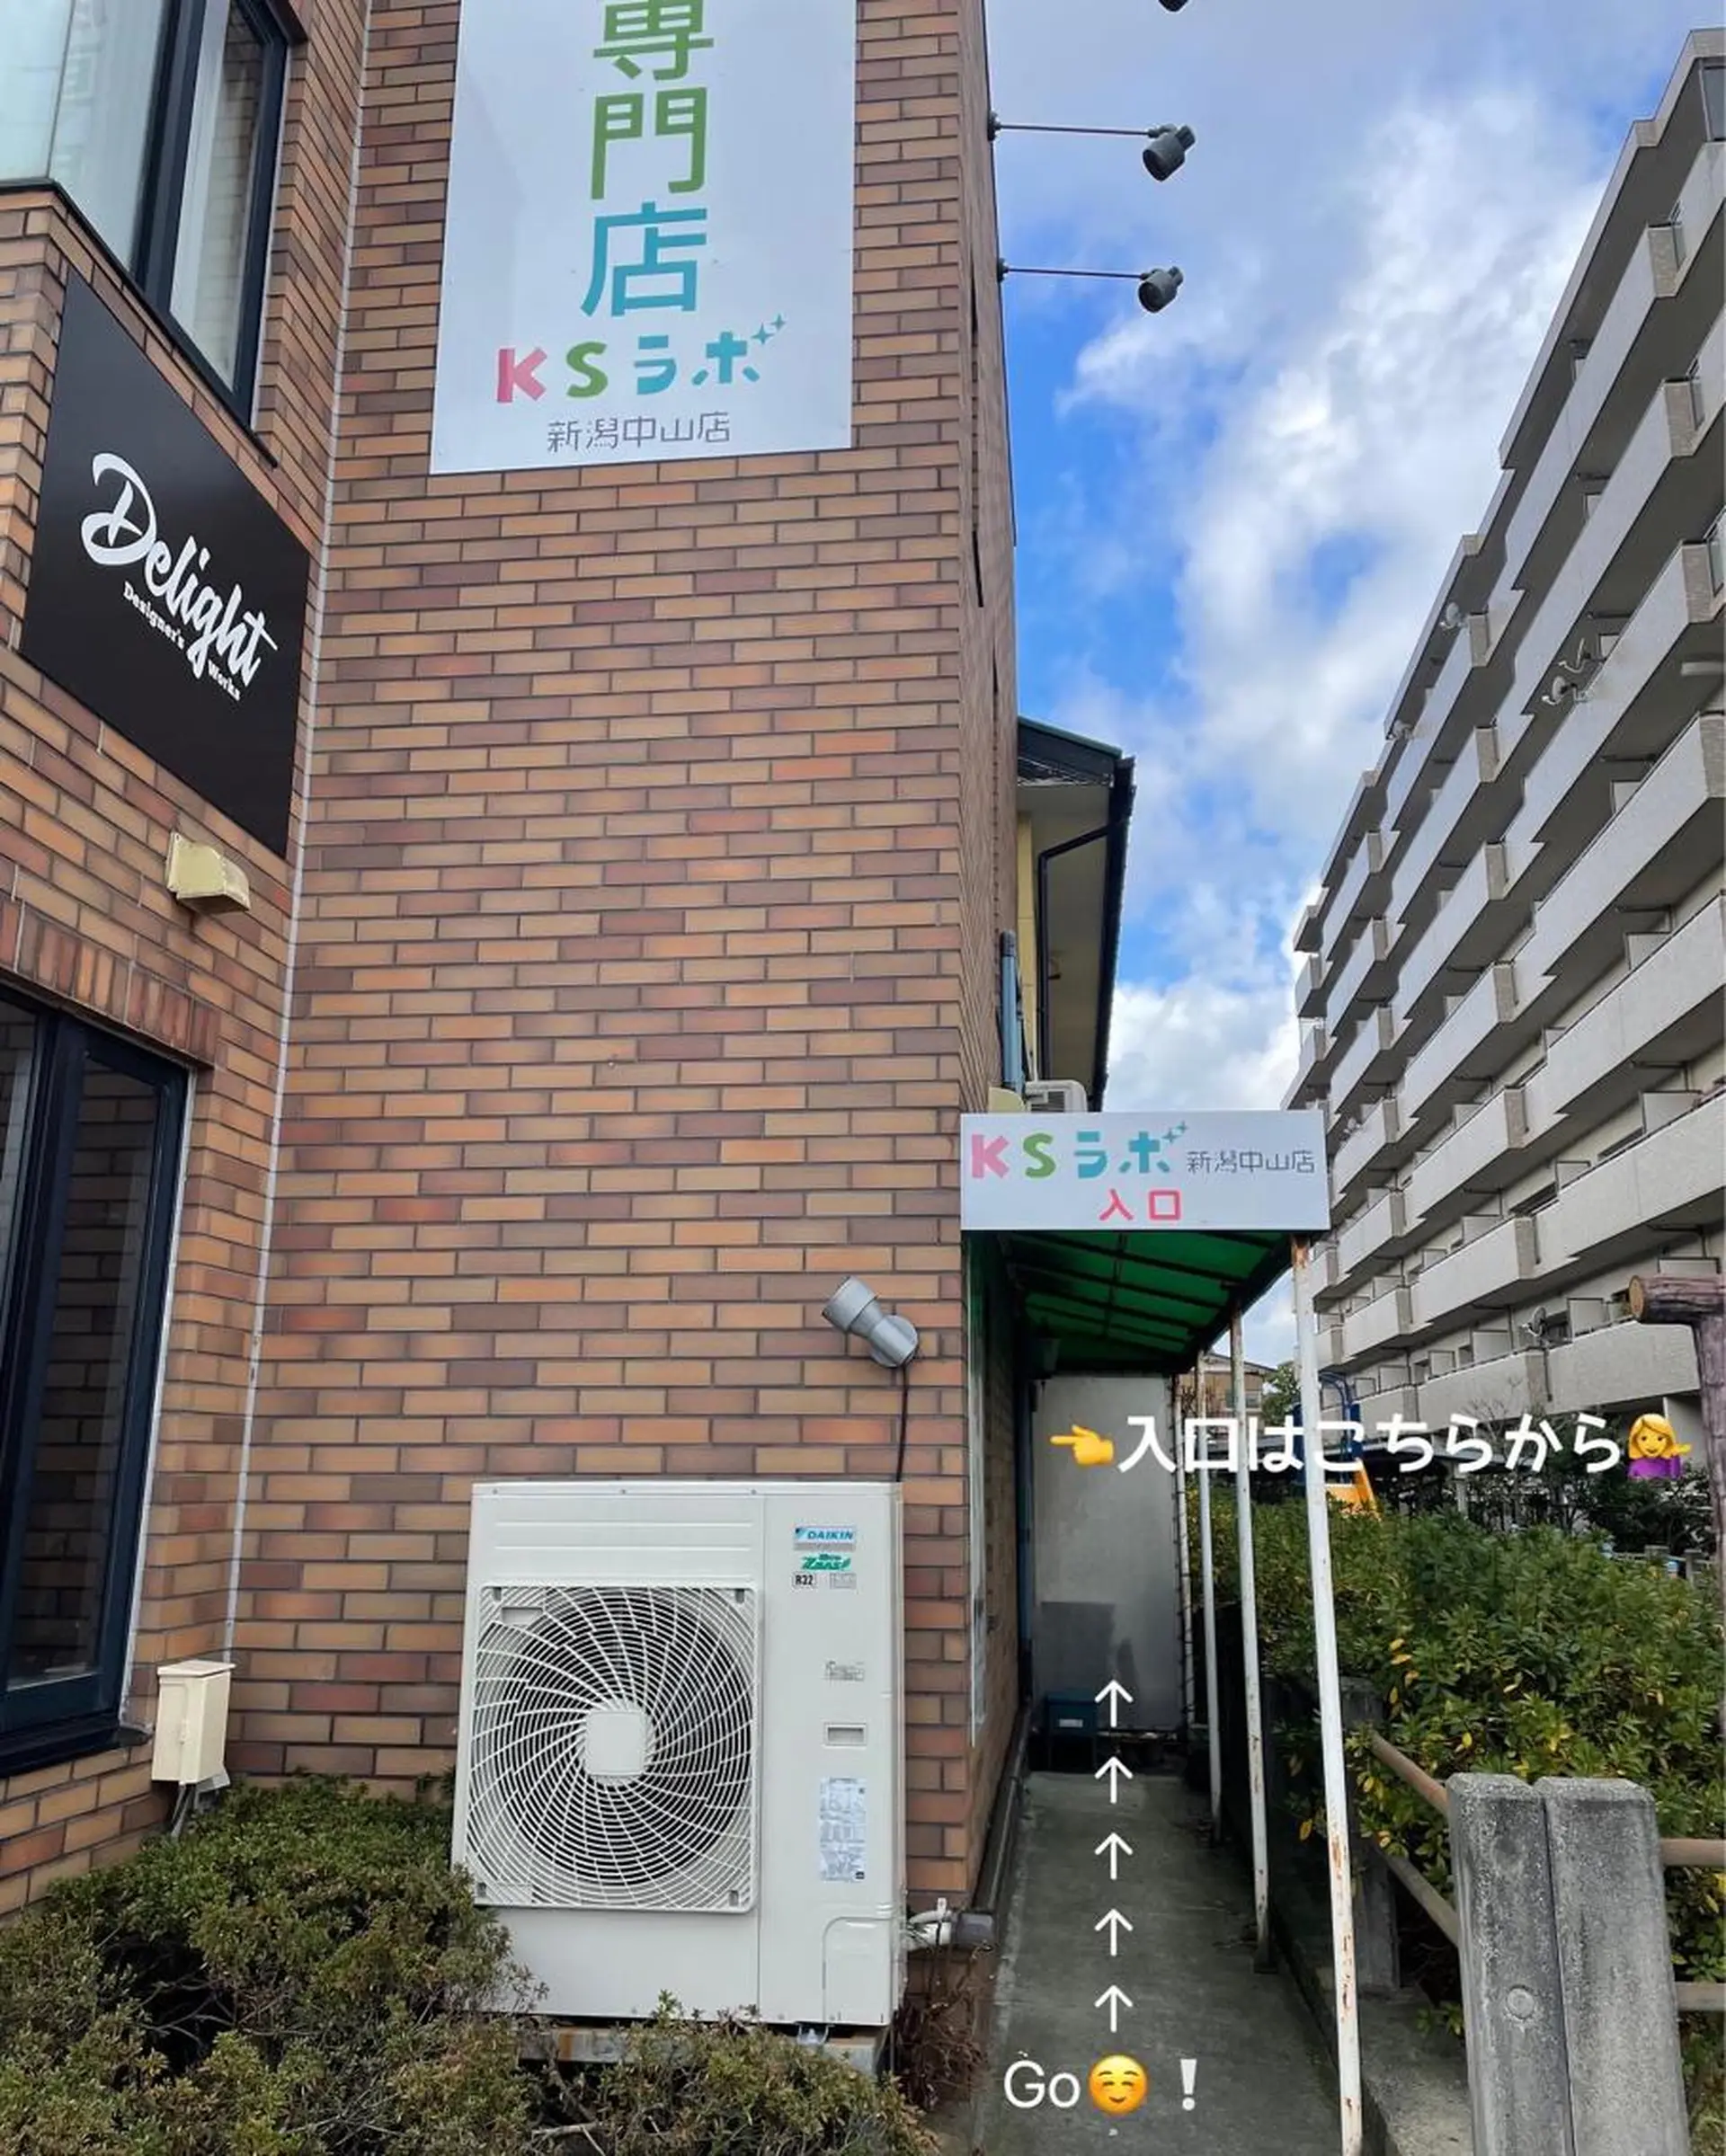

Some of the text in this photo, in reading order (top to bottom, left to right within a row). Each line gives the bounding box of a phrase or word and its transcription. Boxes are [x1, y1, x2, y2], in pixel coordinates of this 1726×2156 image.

[580, 0, 715, 317] 専門店
[547, 412, 731, 453] 新潟中山店
[81, 452, 278, 687] Delight
[207, 659, 242, 701] Works
[1187, 1149, 1315, 1175] 新潟中山店
[1099, 1189, 1182, 1221] 入口
[807, 1530, 854, 1540] DAIKIN
